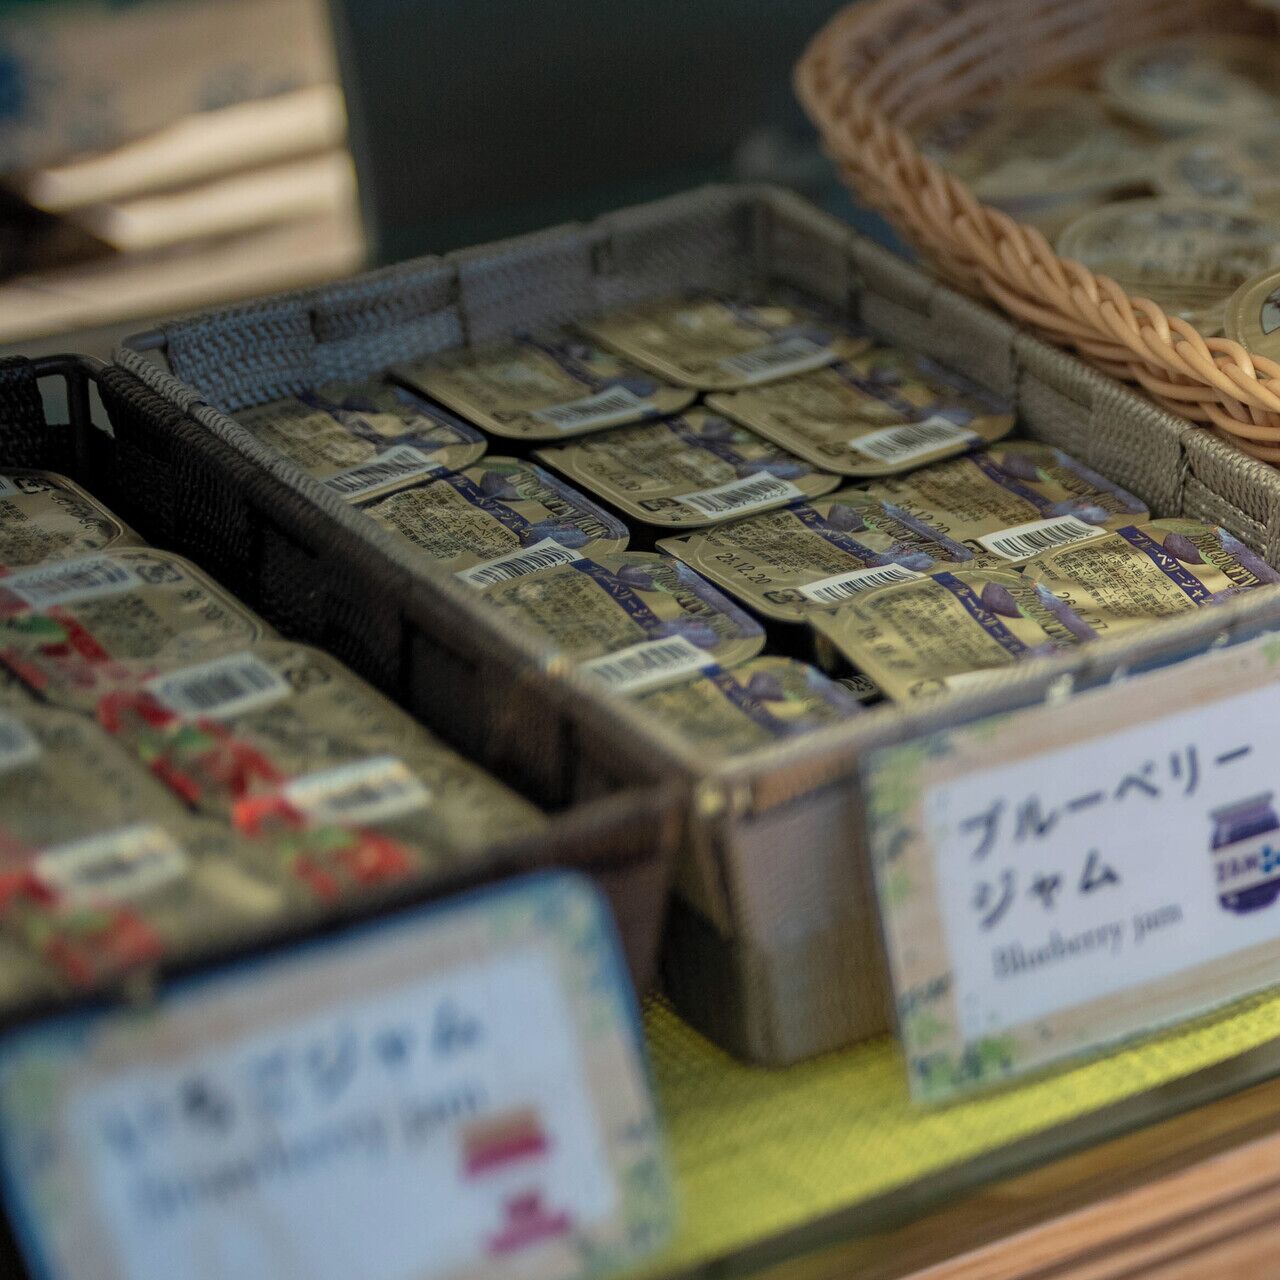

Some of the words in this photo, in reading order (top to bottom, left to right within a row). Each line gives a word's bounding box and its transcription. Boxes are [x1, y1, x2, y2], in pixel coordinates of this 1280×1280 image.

[715, 552, 772, 586] 25.12.20
[1190, 532, 1260, 588] Blueberry
[958, 744, 1252, 862] ブルーベリー
[971, 849, 1121, 933] ジャム
[991, 921, 1124, 979] Blueberry
[1132, 903, 1184, 945] jam
